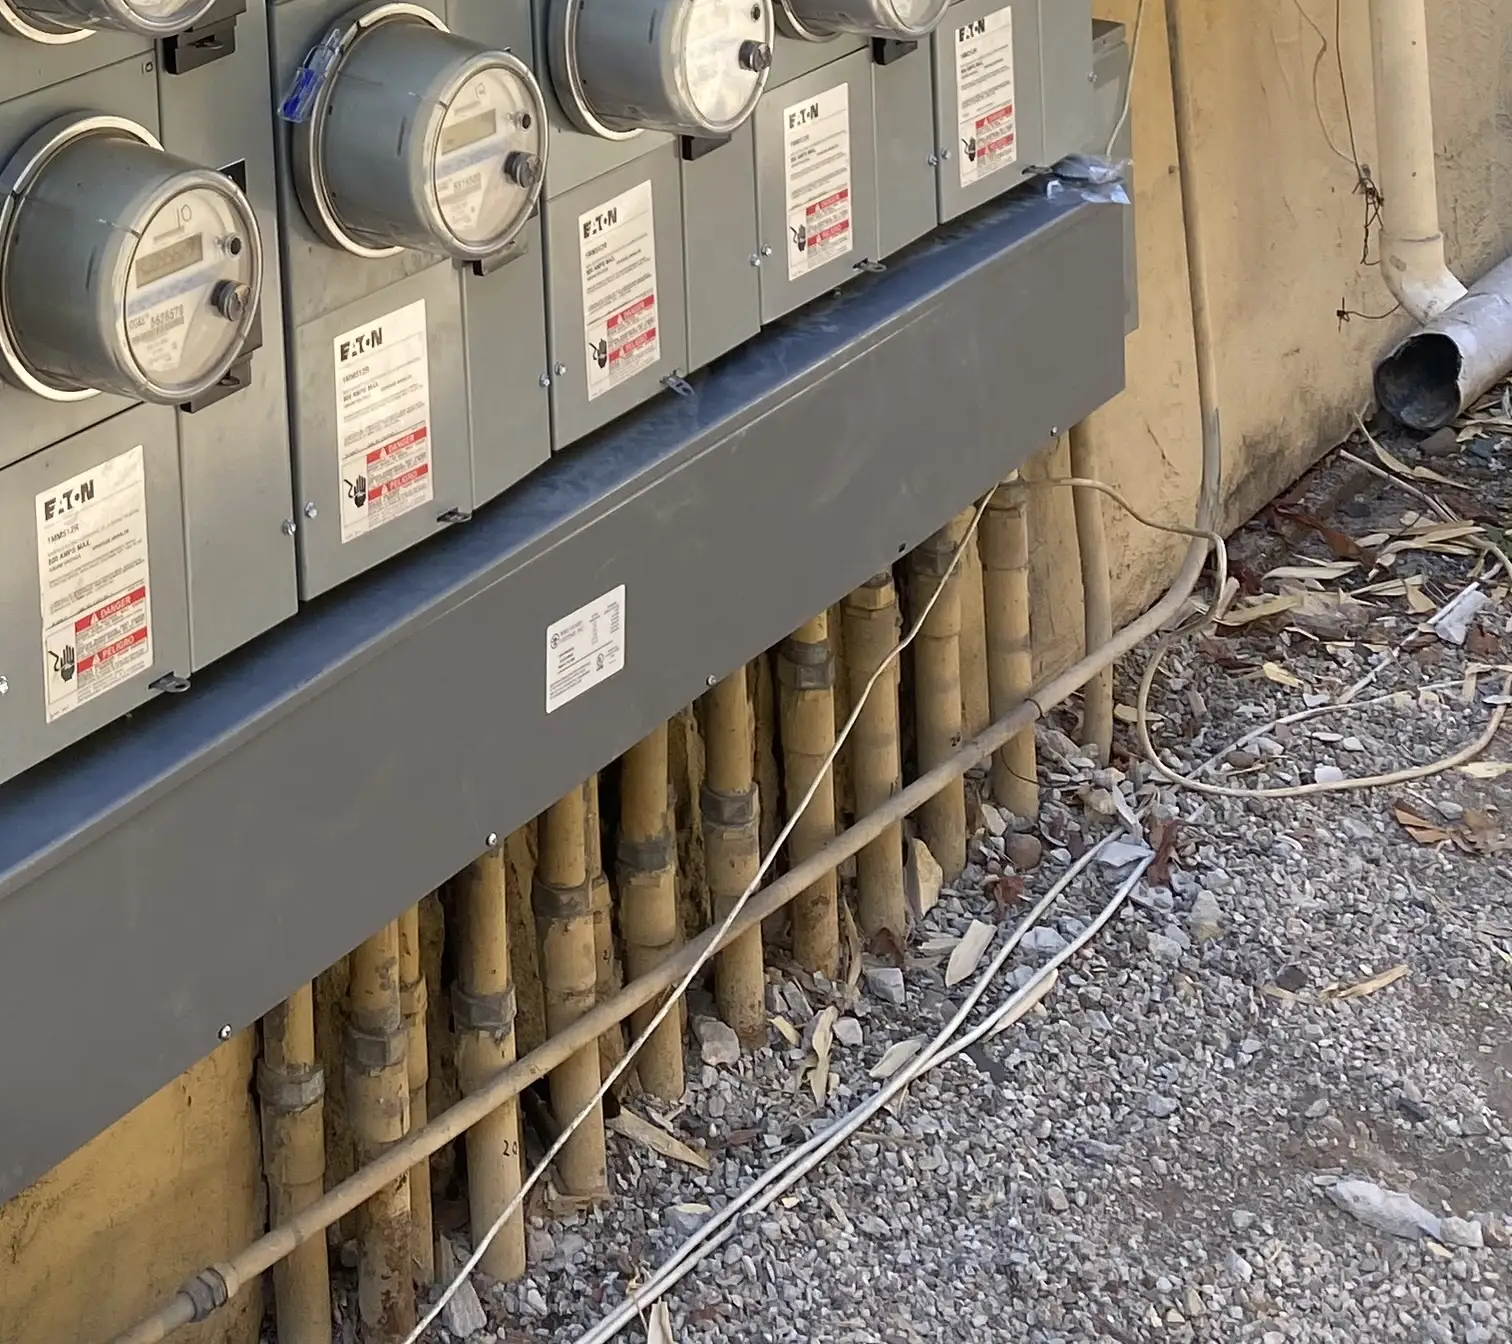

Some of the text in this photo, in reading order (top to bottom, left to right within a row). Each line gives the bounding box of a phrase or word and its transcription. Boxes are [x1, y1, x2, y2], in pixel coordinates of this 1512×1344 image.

[141, 61, 154, 75] 10
[173, 204, 193, 230] 10
[340, 327, 383, 362] EATON
[44, 479, 95, 521] EATON
[100, 595, 132, 618] DANGER
[102, 634, 135, 660] PELIGRO
[502, 1140, 517, 1157] 20
